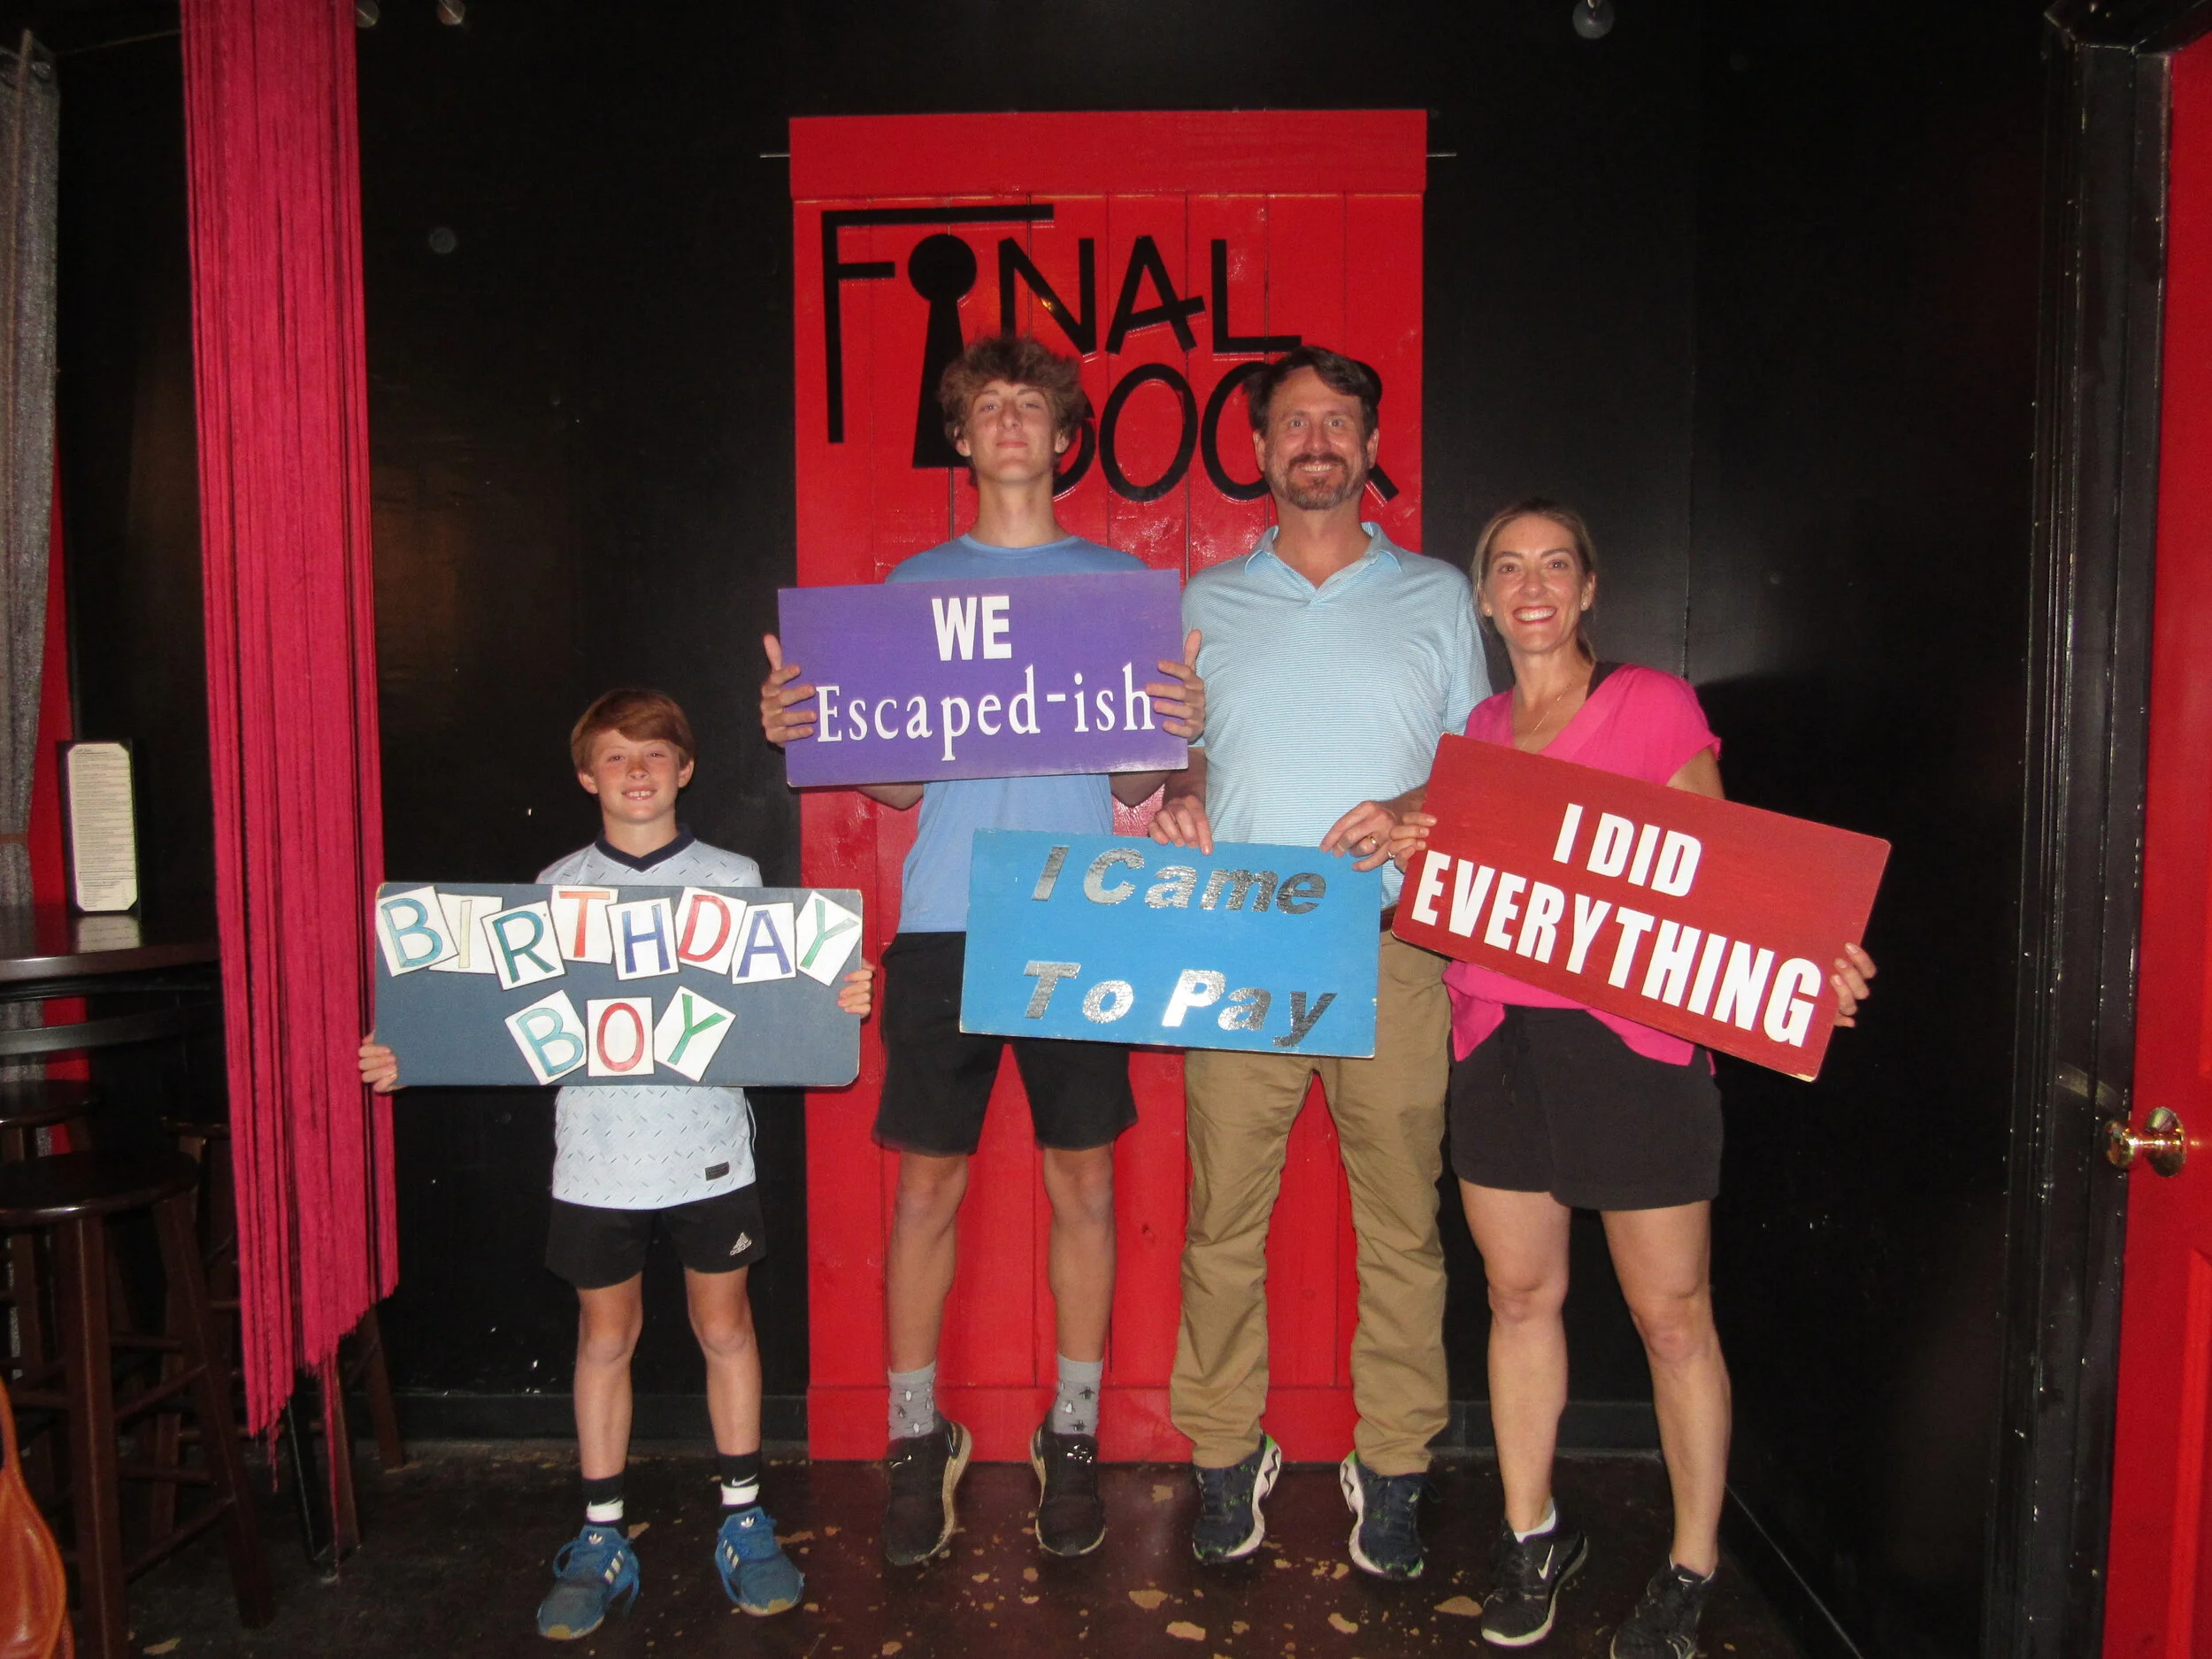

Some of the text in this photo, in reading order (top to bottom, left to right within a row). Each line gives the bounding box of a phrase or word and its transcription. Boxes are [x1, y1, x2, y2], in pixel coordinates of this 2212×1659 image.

[821, 204, 1303, 468] FINAL
[931, 595, 1012, 662] WE
[816, 662, 1156, 762] Escaped-ish
[1030, 845, 1327, 914] I Came
[1552, 802, 1702, 898] I DID
[380, 890, 859, 984] BIRTHDAY
[1410, 849, 1823, 1048] EVERYTHING
[518, 993, 727, 1078] BOY
[1023, 960, 1339, 1048] To Pay
